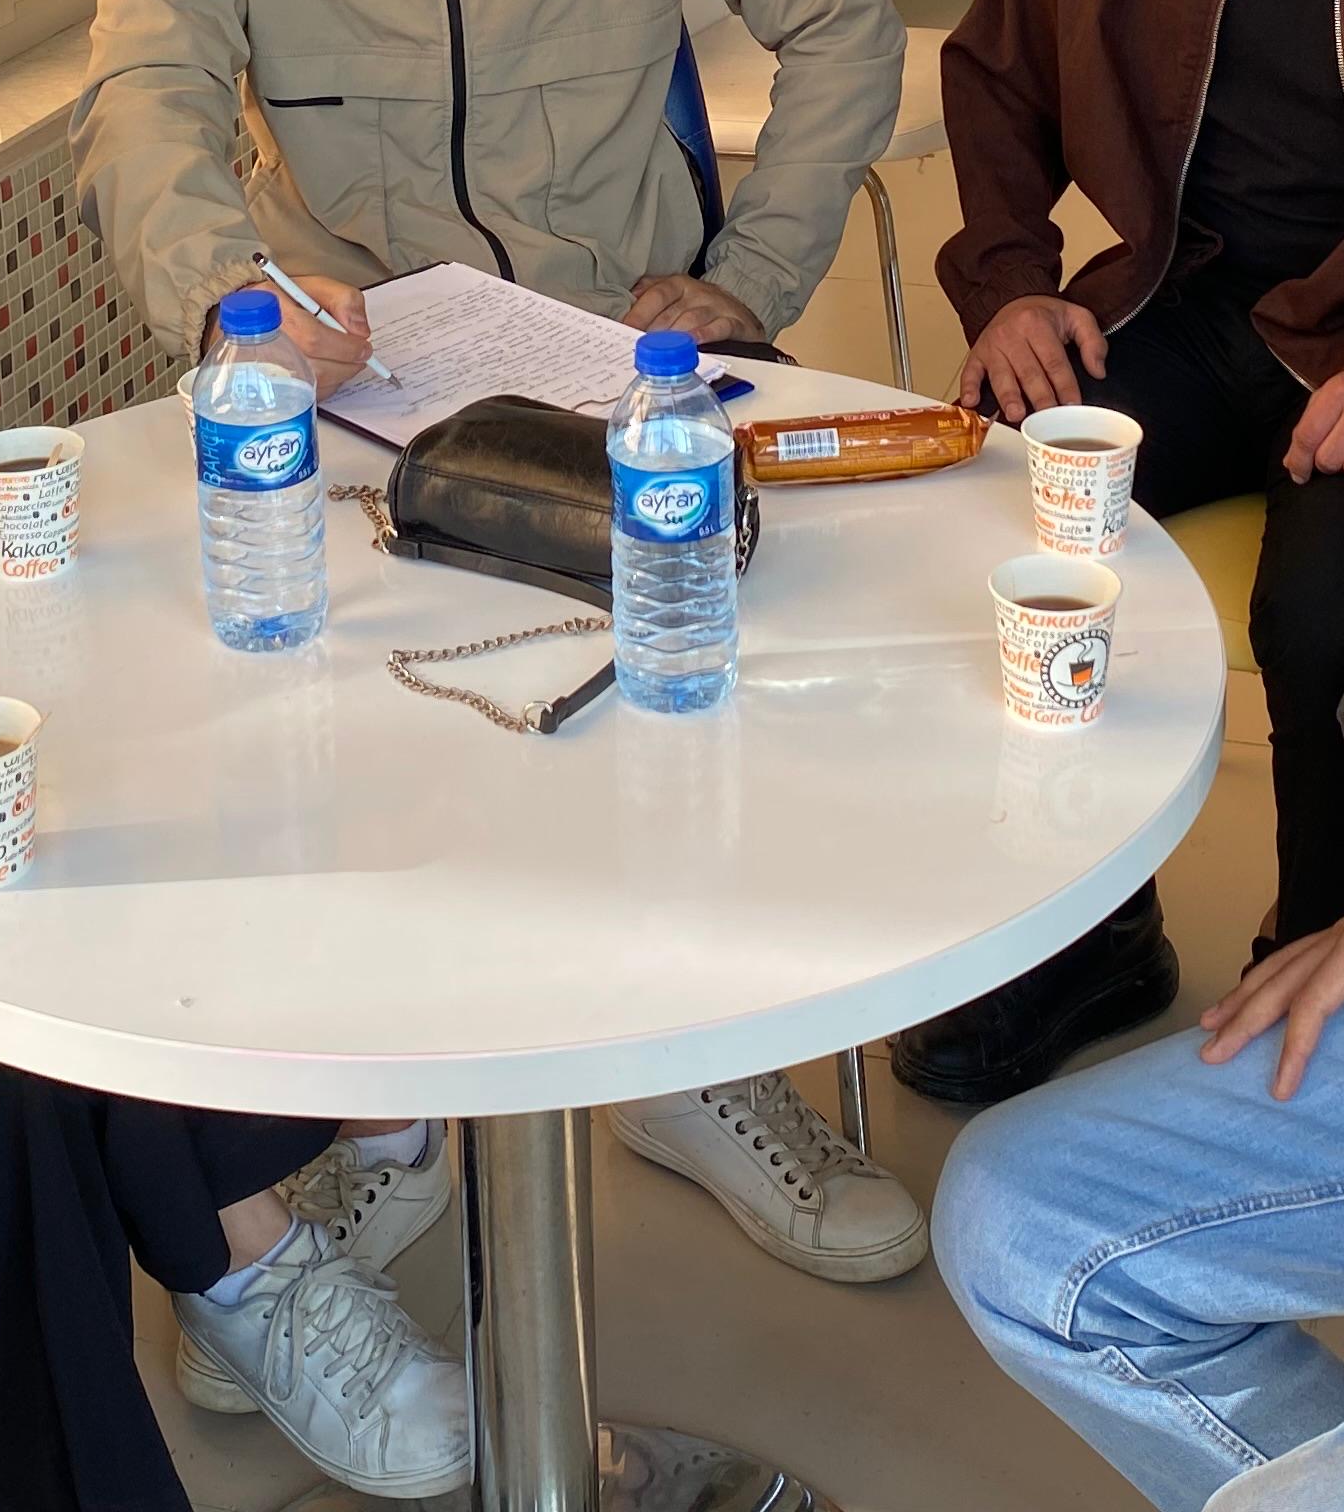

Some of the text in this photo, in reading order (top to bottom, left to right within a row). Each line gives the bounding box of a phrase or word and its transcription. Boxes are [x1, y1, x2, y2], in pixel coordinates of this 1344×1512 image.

[199, 419, 225, 487] BAHÇE
[243, 437, 301, 466] ayran
[1037, 468, 1097, 487] Chocolate
[1044, 461, 1097, 477] Espresso
[38, 485, 65, 499] Latte
[641, 489, 703, 515] ayran
[1042, 485, 1096, 511] Coffee
[664, 510, 684, 525] Su
[1059, 522, 1084, 536] Latte
[1, 540, 57, 559] Kakao
[1040, 534, 1093, 556] Hot Coffee
[2, 558, 59, 579] Coffee
[1014, 702, 1031, 720] Hot
[1034, 709, 1075, 725] Coffee
